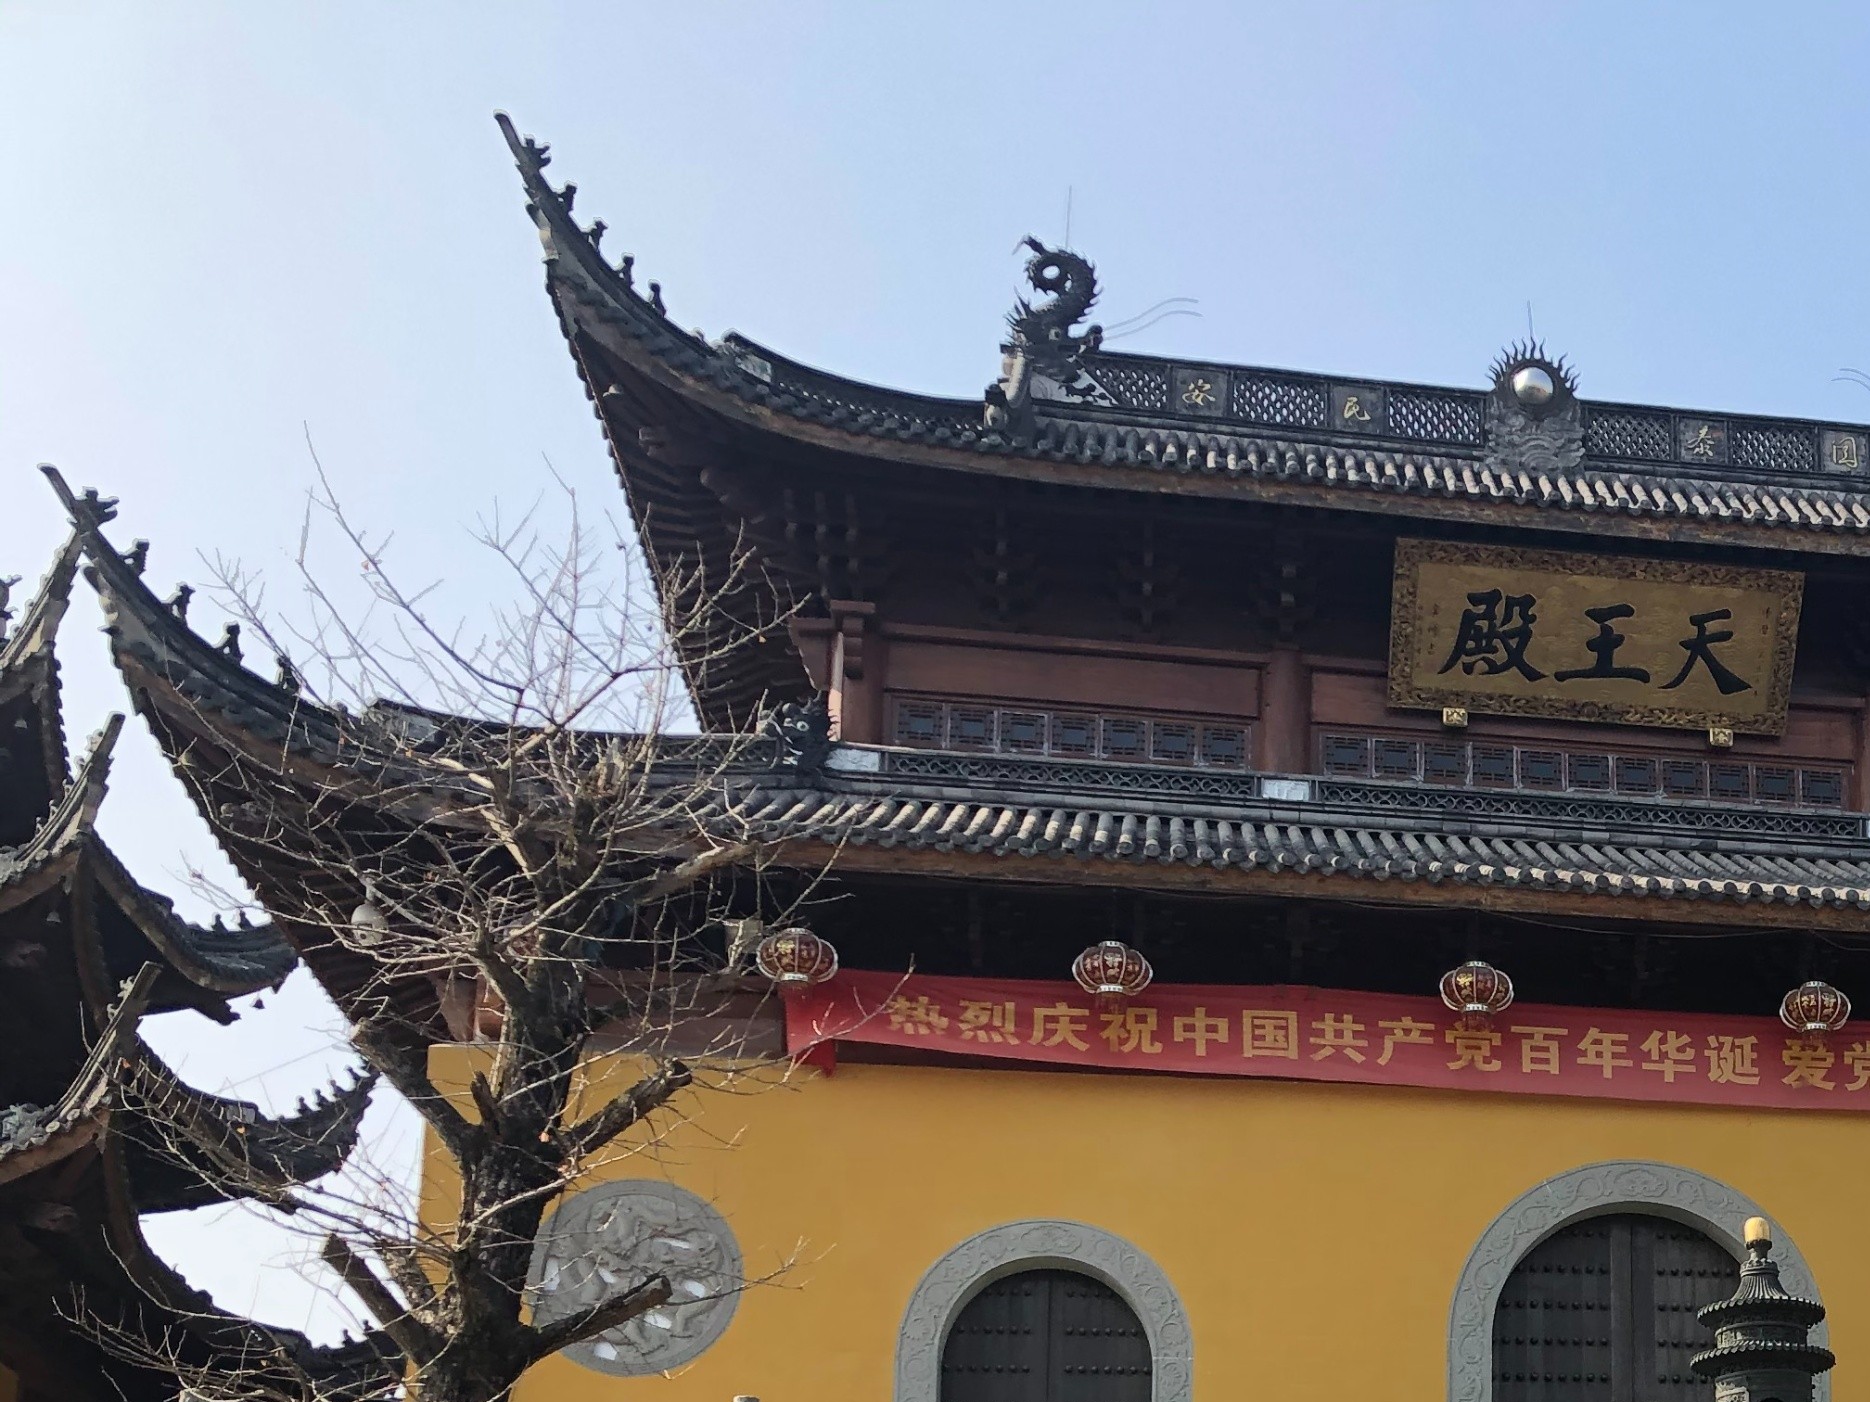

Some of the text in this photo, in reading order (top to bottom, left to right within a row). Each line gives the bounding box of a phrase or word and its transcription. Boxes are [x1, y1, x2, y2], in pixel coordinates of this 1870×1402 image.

[1437, 587, 1753, 695] 天王殿
[887, 994, 1762, 1086] 热烈庆祝中国共产党百年华诞
